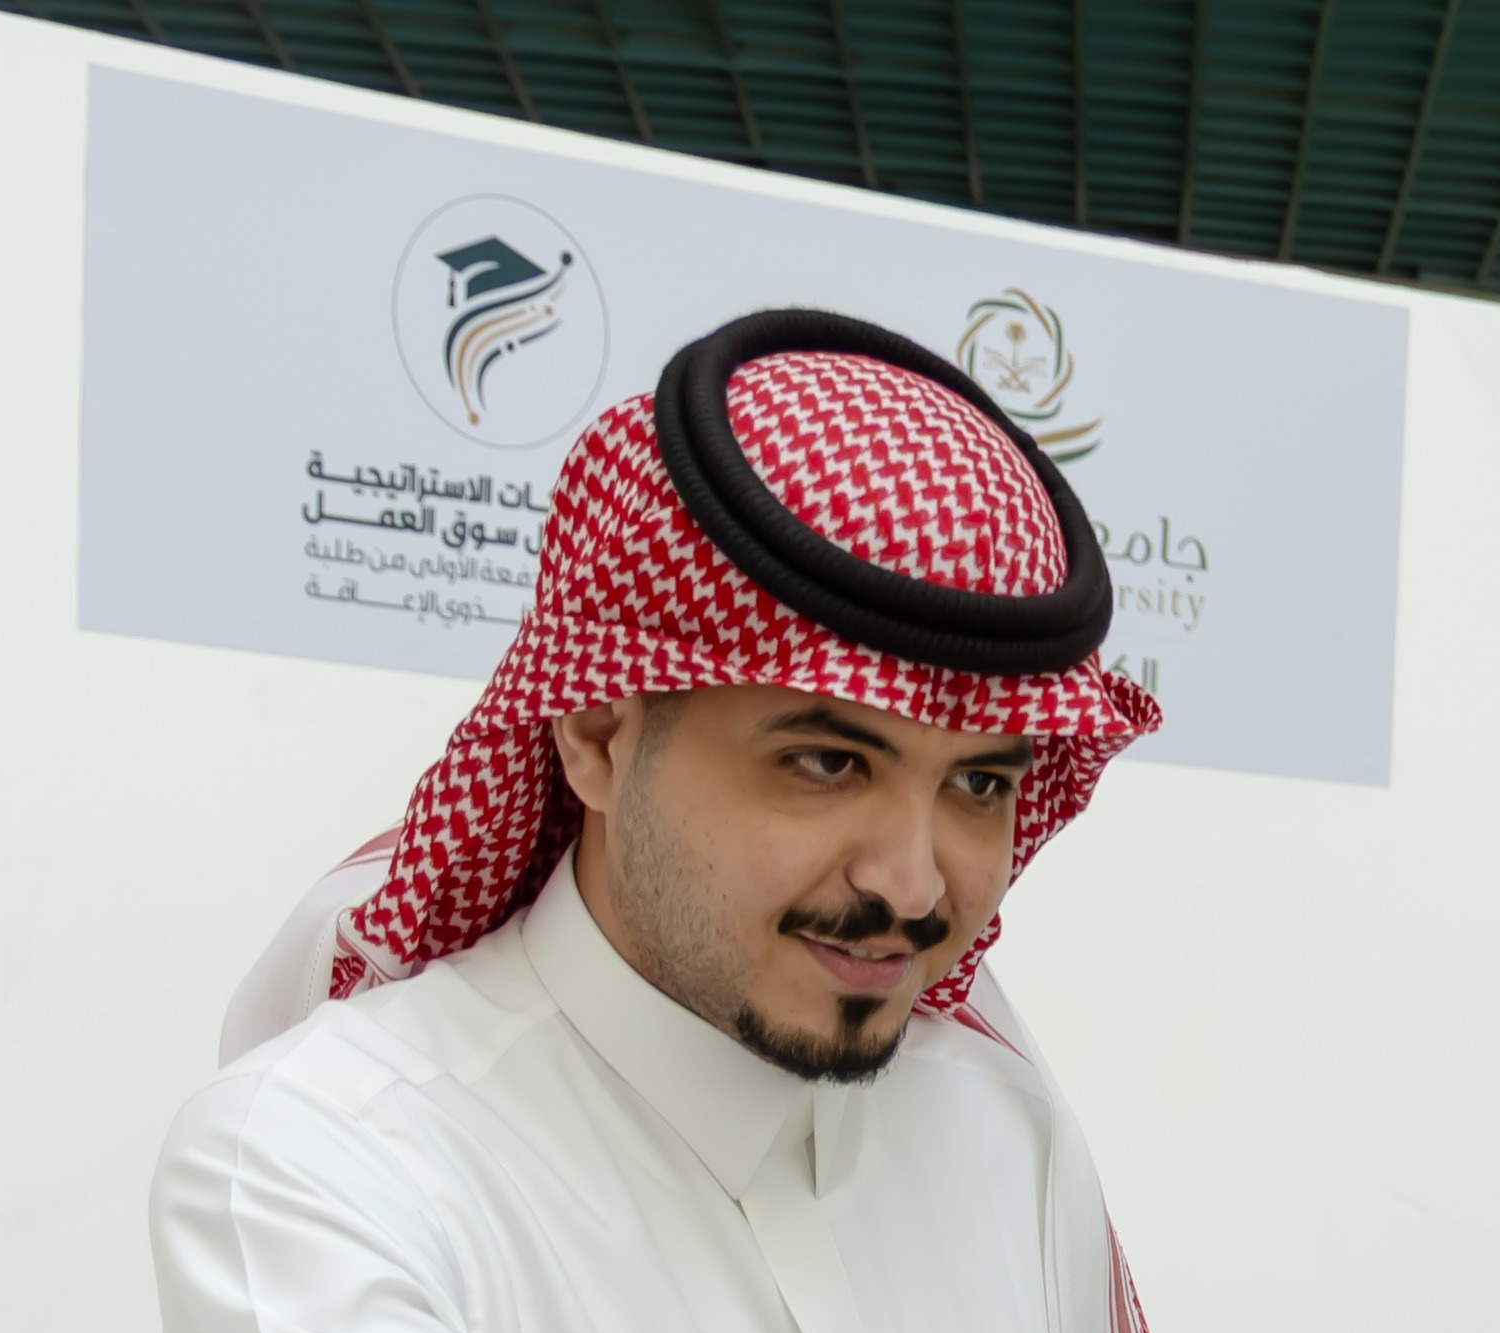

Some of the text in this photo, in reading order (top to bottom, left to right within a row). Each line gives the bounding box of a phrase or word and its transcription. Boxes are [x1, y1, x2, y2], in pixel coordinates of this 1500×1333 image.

[306, 449, 492, 503] الاستراتيجية
[301, 489, 435, 535] العمل
[441, 508, 518, 549] سوق
[368, 546, 408, 573] من
[1117, 576, 1206, 632] rsity
